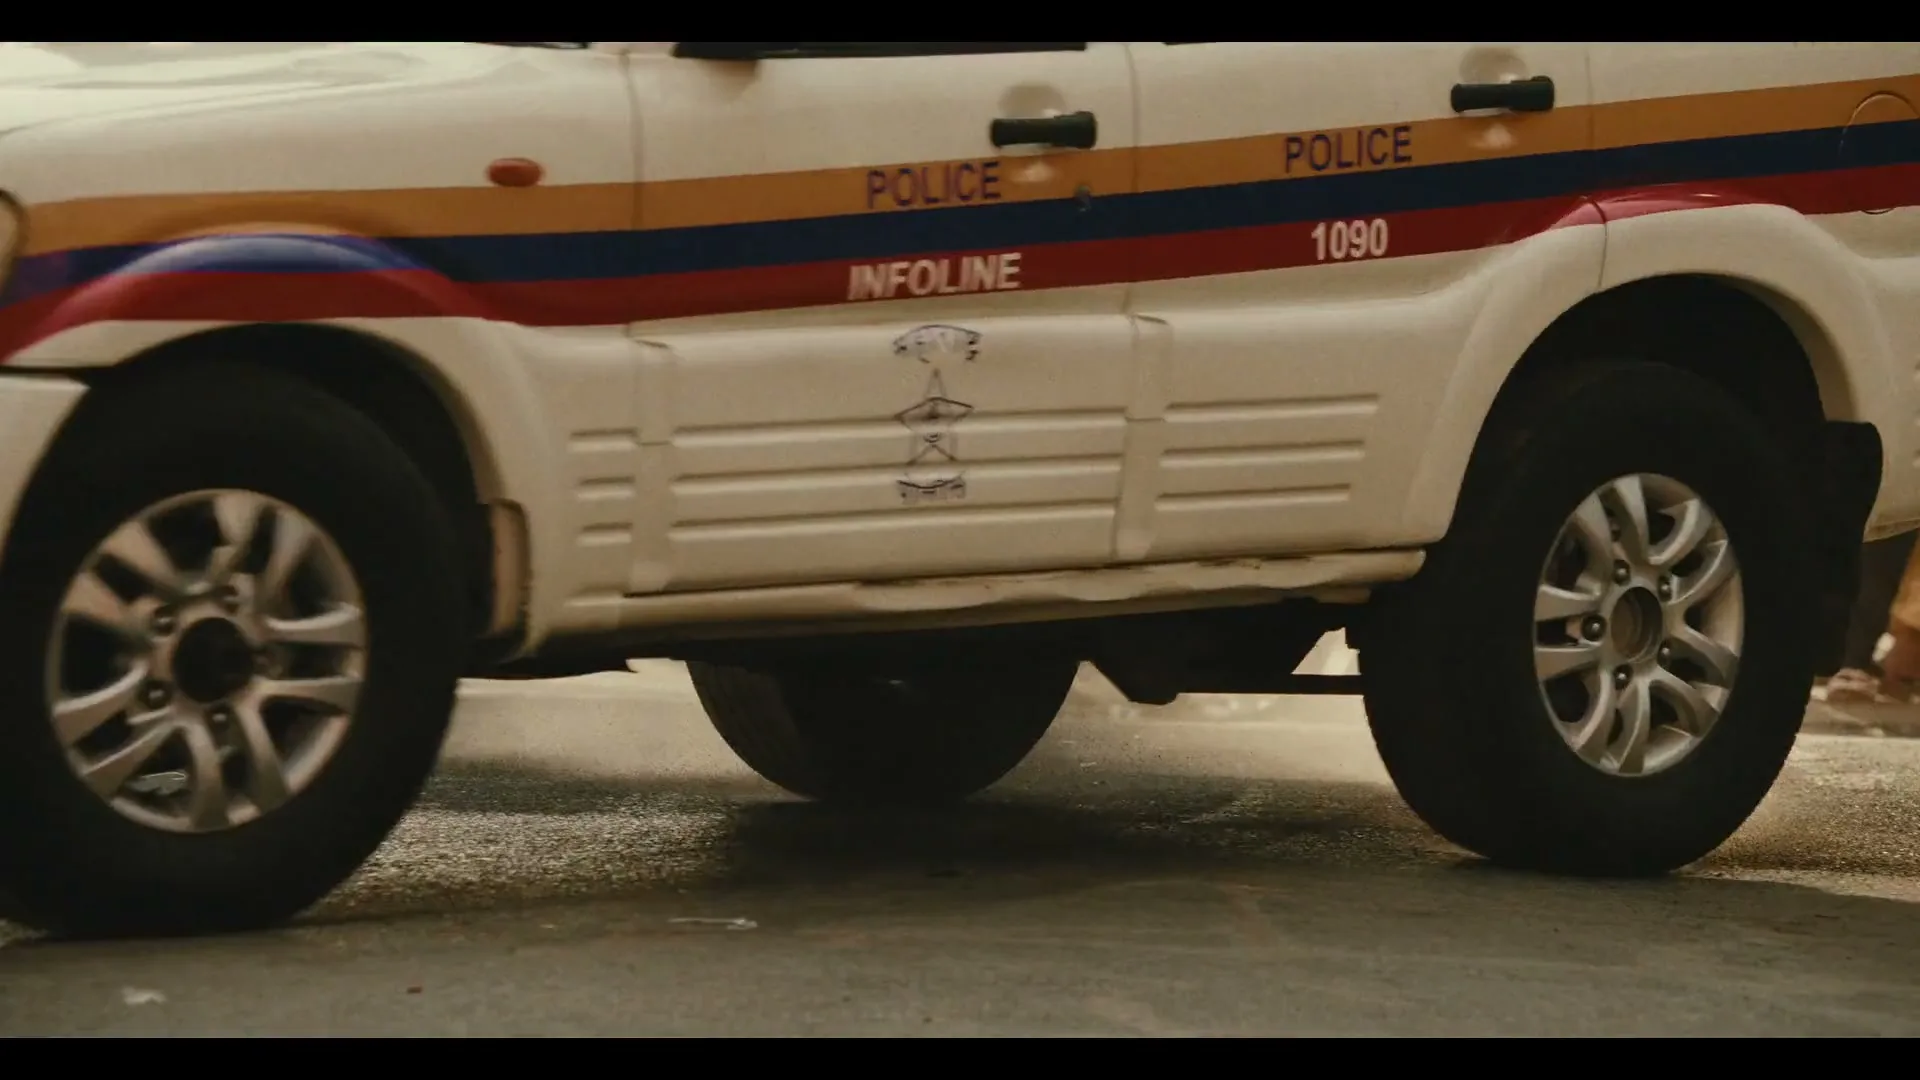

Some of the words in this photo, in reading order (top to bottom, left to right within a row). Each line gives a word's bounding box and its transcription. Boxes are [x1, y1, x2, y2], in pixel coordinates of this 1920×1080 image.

[1285, 125, 1412, 173] POLICE
[867, 161, 1001, 208] POLICE
[1311, 218, 1388, 260] 1090
[848, 252, 1022, 300] INFOLINE
